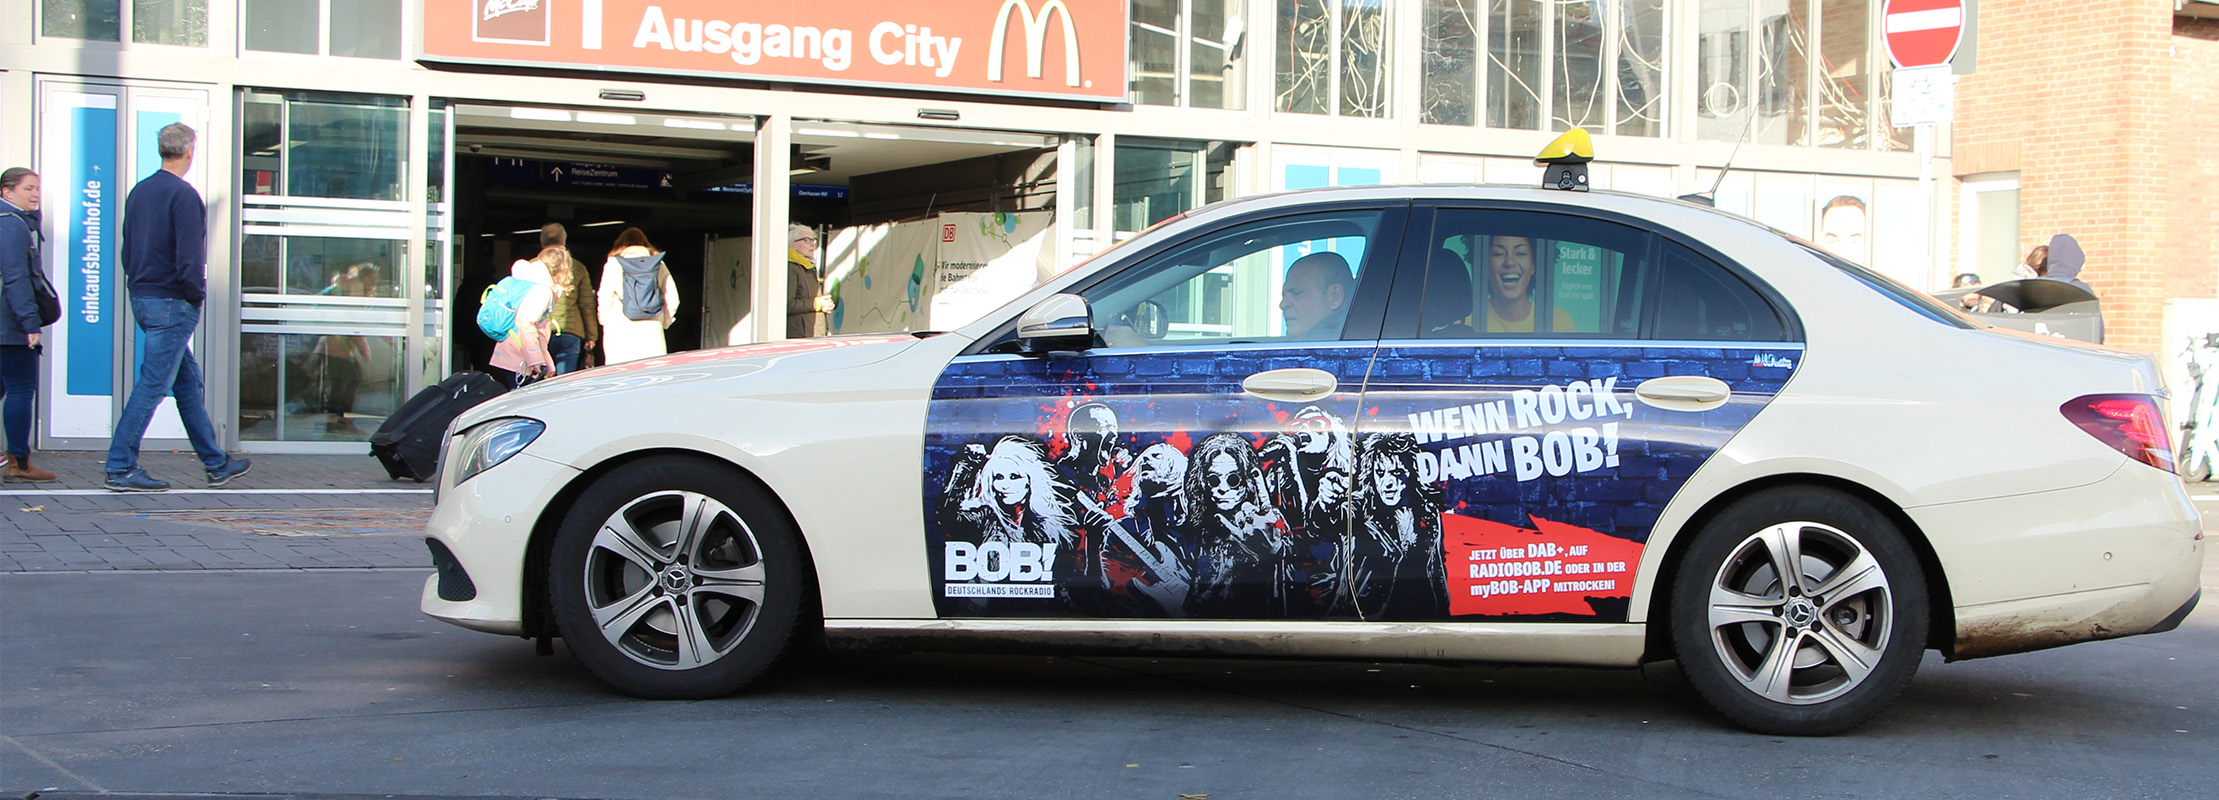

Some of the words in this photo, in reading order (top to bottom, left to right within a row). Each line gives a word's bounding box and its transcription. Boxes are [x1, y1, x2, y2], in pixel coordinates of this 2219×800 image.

[632, 5, 852, 71] Ausgang
[868, 21, 963, 78] City
[571, 167, 618, 178] ReiseZentrum
[943, 226, 955, 241] DB
[81, 180, 102, 324] einkaufsbahnhof.de
[1560, 246, 1587, 260] Stark
[1588, 247, 1597, 260] &
[1562, 261, 1593, 275] lecker
[1408, 400, 1510, 445] WENN
[1512, 376, 1634, 429] ROCK,
[1416, 440, 1508, 484] DANN
[1511, 421, 1620, 482] BOB!
[945, 541, 1058, 582] BOB!
[1469, 549, 1497, 561] JETZT
[1500, 547, 1525, 560] ÜBER
[1569, 545, 1589, 557] AUF
[1469, 560, 1563, 579] RADIOBOB.DE
[1564, 563, 1590, 574] ODER
[1592, 562, 1605, 573] IN
[1607, 561, 1626, 573] DER
[947, 586, 1006, 595] DEUTSCHLANDS
[1009, 587, 1052, 596] ROCKRADIO
[1470, 578, 1551, 599] myBOB-APP
[1553, 580, 1616, 593] MITROCKEN!
